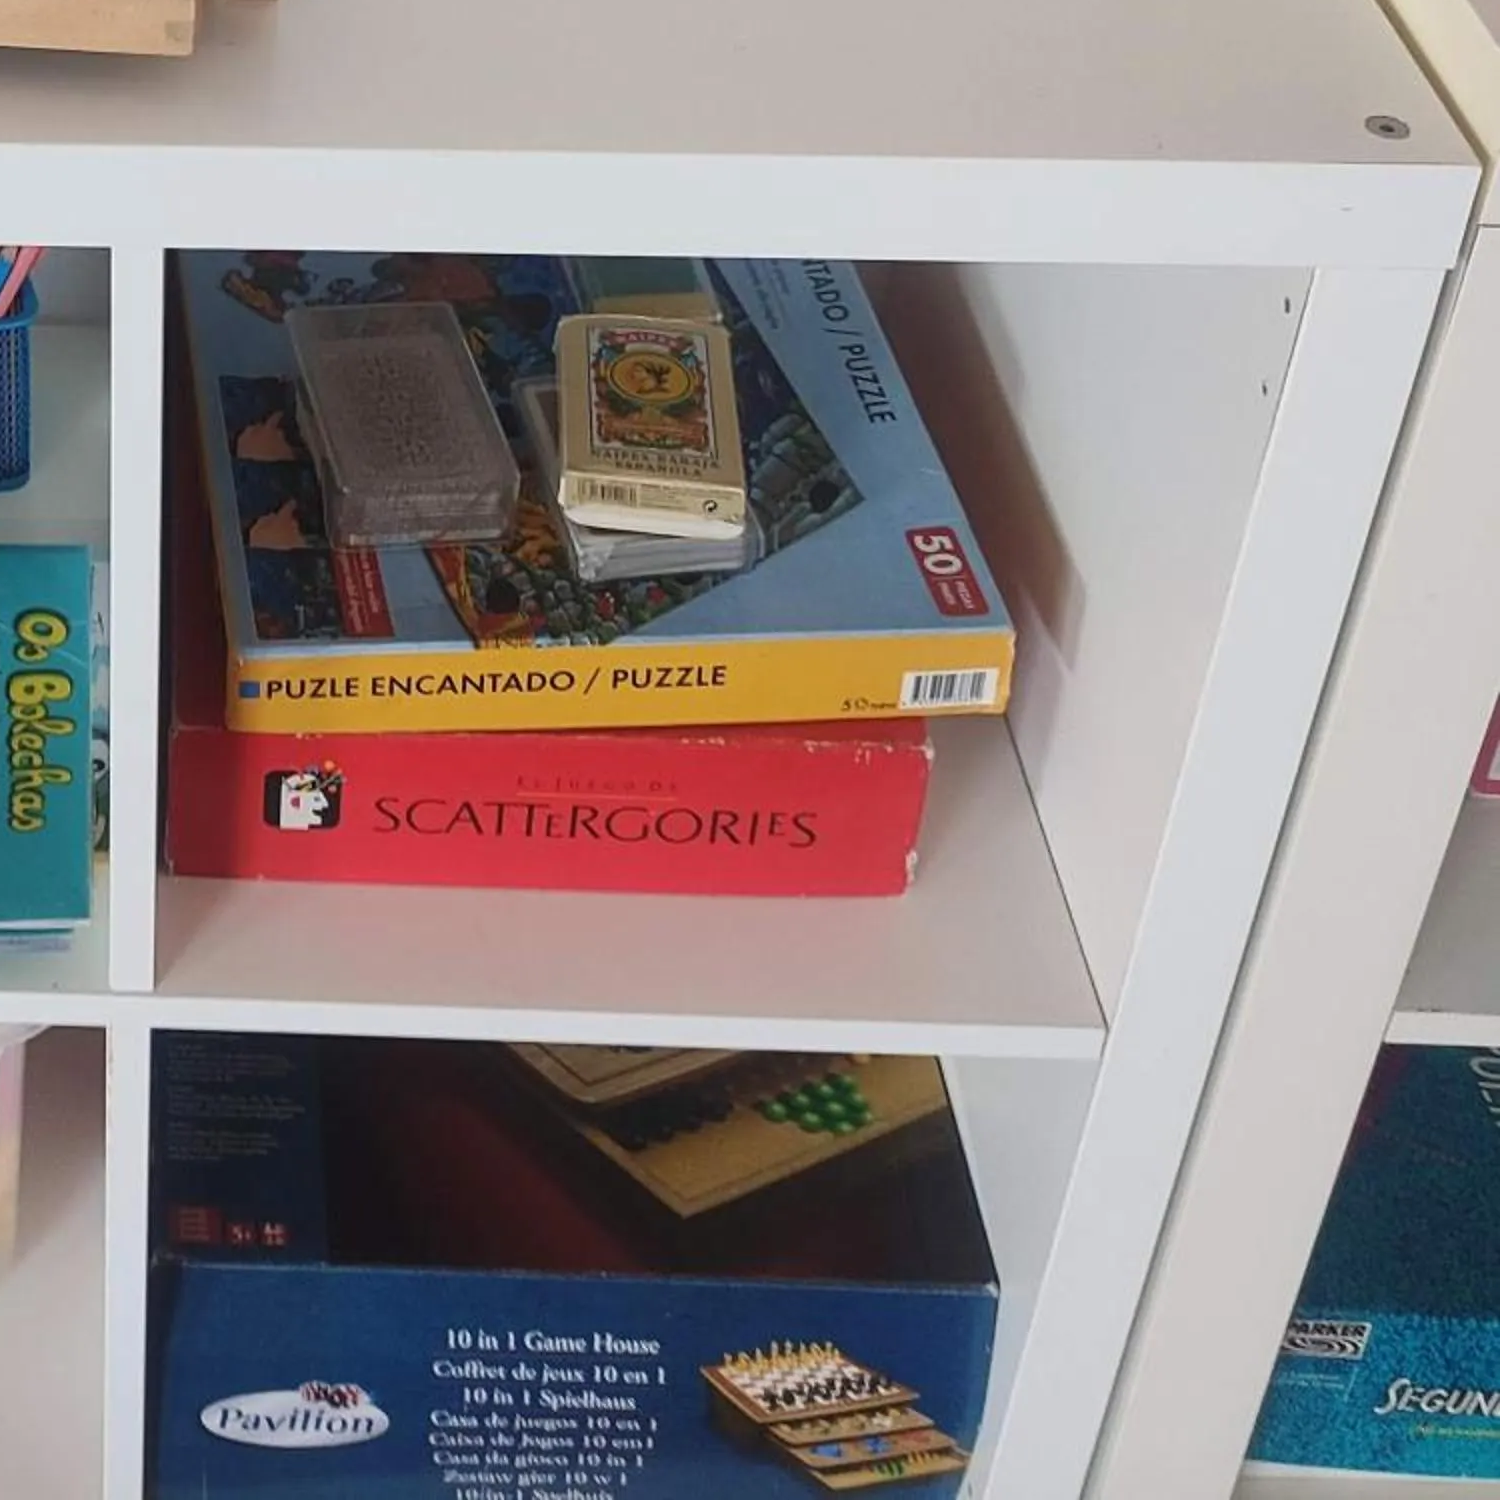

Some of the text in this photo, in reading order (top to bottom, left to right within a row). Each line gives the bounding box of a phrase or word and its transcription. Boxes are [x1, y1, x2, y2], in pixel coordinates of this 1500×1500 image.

[839, 344, 897, 423] PUZZLE
[913, 535, 963, 575] 50
[266, 665, 728, 699] PUZLE ENCANTADO / PUZZLE
[6, 607, 77, 833] Os Bolechas
[373, 796, 817, 849] SCATTERGORIES
[448, 1328, 660, 1355] 10 in 1 Game House
[432, 1360, 667, 1386] Coffret de jeux 10 en 1
[464, 1386, 637, 1411] 10 in 1 Spielhaus
[219, 1407, 374, 1435] Pavilion
[430, 1409, 479, 1428] Casa
[484, 1411, 509, 1428] de
[513, 1413, 578, 1432] juegos
[587, 1416, 611, 1430] 10
[490, 1433, 514, 1448] de
[583, 1435, 606, 1448] 10
[433, 1450, 480, 1466] Casa
[577, 1453, 601, 1467] 10
[565, 1471, 588, 1485] 10
